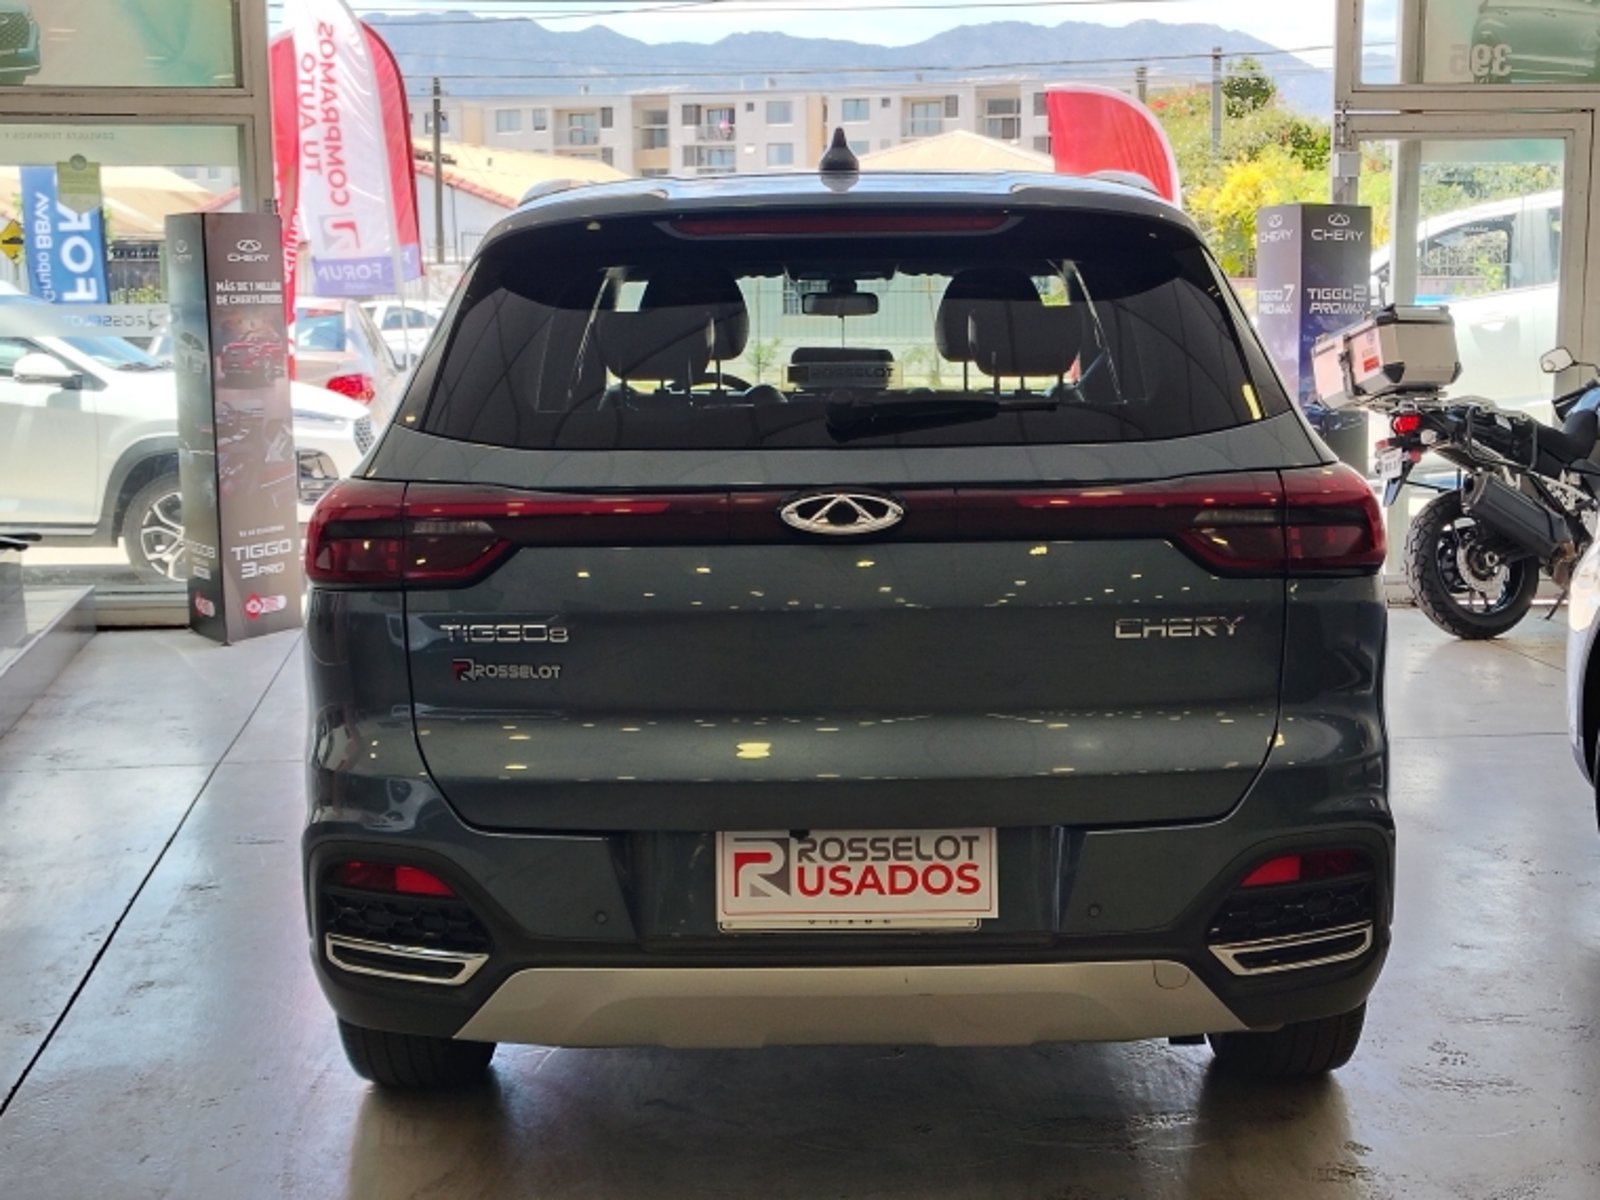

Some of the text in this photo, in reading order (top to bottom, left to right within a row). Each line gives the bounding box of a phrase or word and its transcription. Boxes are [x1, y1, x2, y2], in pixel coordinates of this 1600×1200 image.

[1311, 228, 1364, 241] CHERY
[230, 538, 292, 561] TIGGO
[1115, 616, 1245, 639] CHERY
[475, 664, 561, 680] ROSSELOT
[797, 835, 980, 863] ROSSELOT
[797, 863, 982, 897] USADOS
